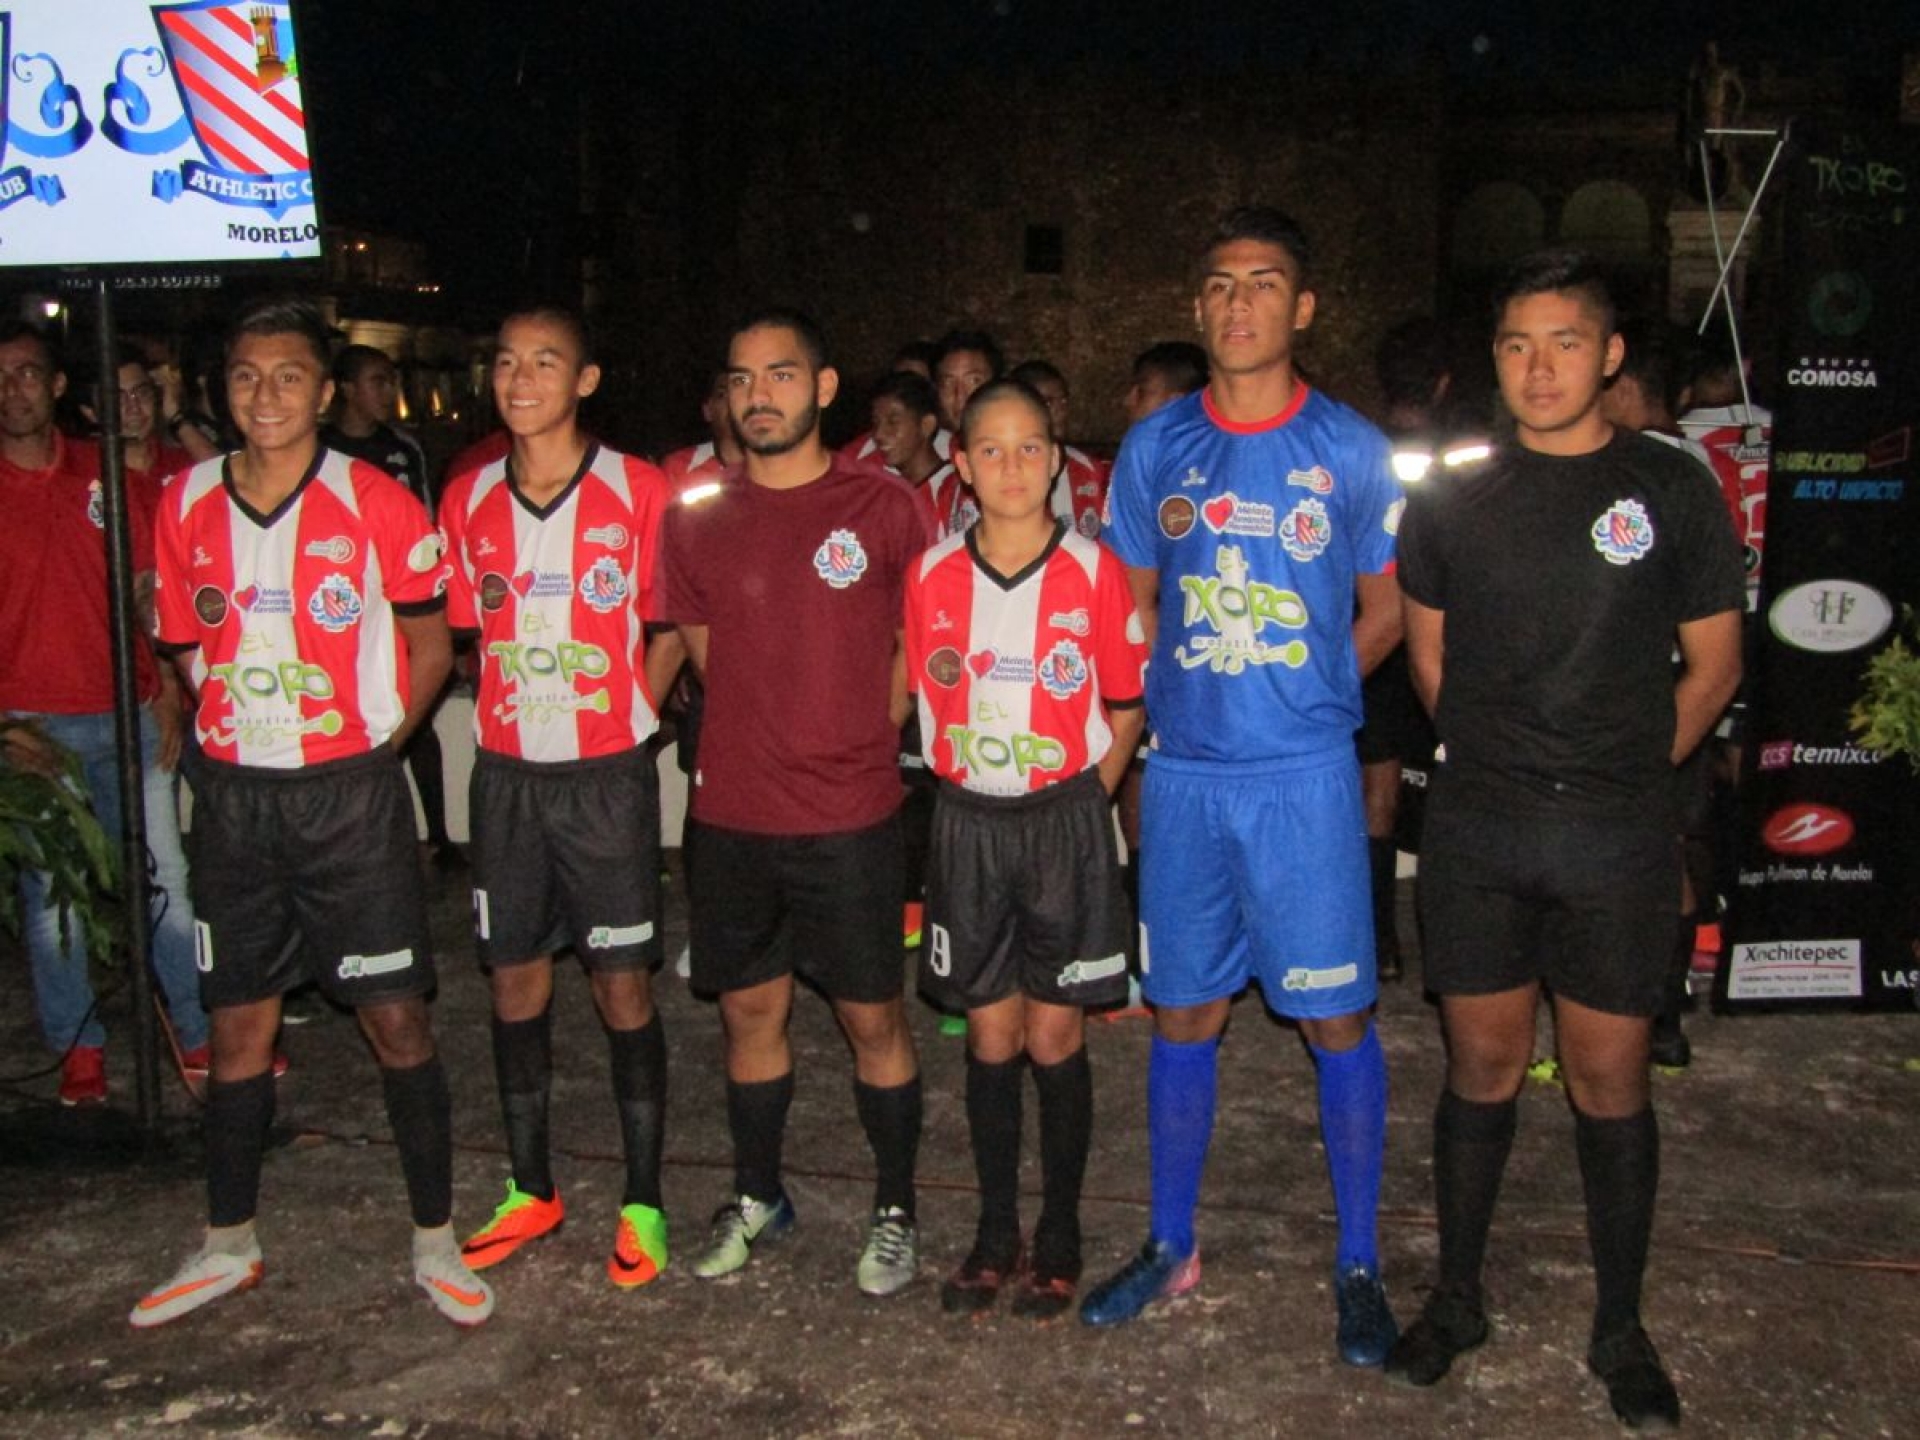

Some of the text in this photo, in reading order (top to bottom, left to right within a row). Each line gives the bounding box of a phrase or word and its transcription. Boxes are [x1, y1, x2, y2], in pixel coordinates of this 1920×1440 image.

[190, 169, 297, 201] ATHLETIC
[1787, 369, 1877, 387] COMOSA
[1811, 862, 1827, 881] de
[1744, 943, 1849, 965] Xochitepec
